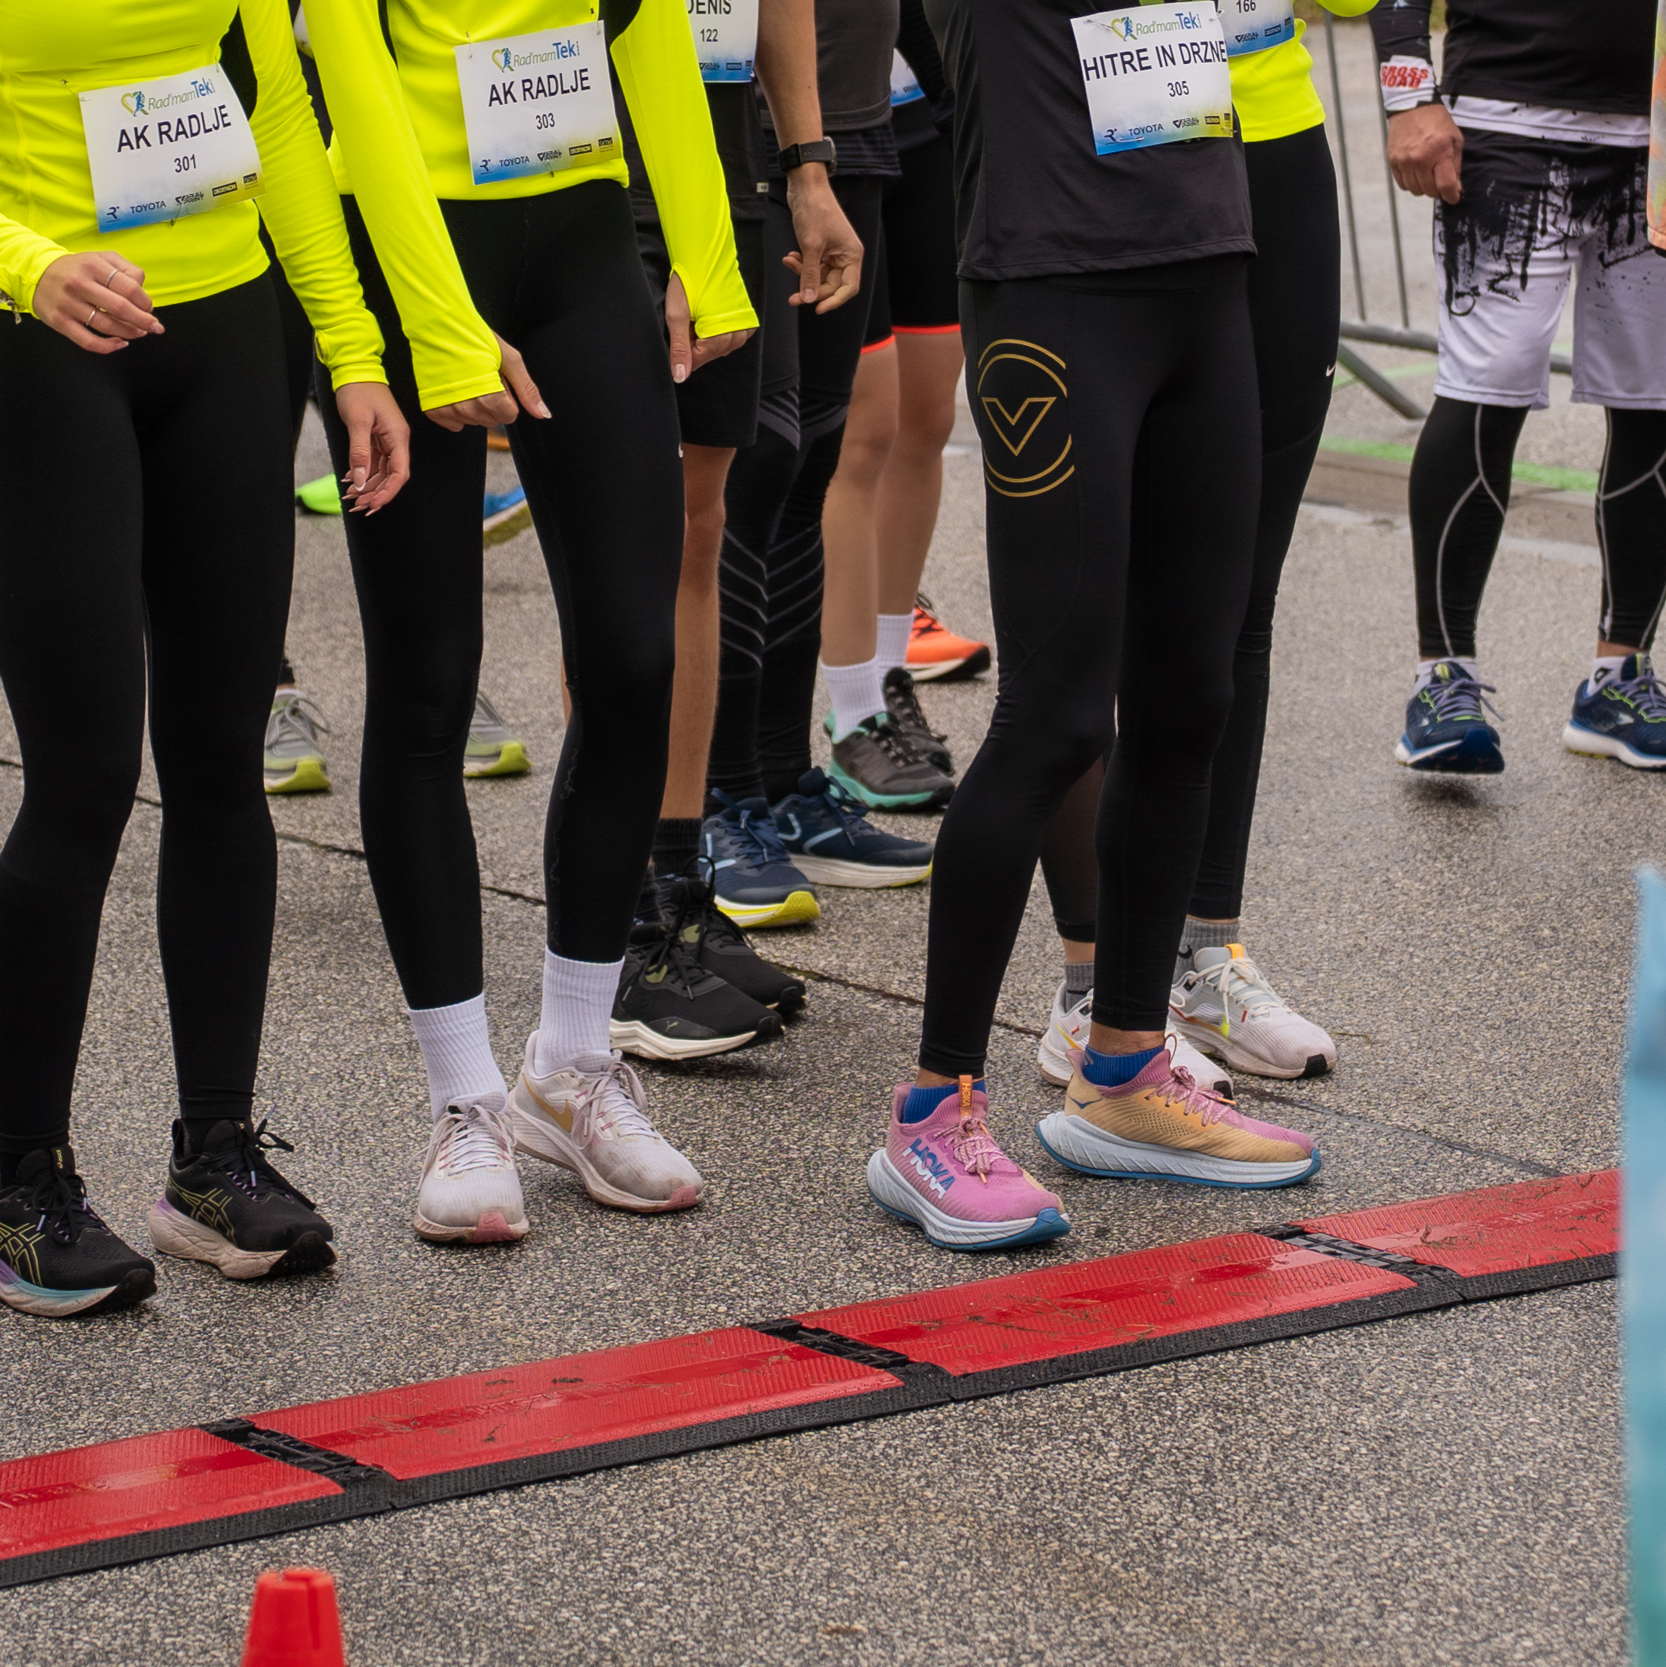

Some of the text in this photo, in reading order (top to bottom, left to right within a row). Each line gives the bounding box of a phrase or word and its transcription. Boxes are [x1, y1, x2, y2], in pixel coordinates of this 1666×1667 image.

[699, 29, 719, 42] 122
[1083, 40, 1228, 82] HITRE IN DRZNE
[488, 68, 591, 107] AK RADLJE
[1167, 80, 1190, 98] 305
[117, 104, 232, 153] AK RADLJE
[535, 112, 556, 130] 303
[1128, 123, 1164, 137] TOYOTA
[174, 154, 197, 173] 301
[499, 156, 530, 168] TOYOTA
[130, 200, 167, 215] TOYOTA
